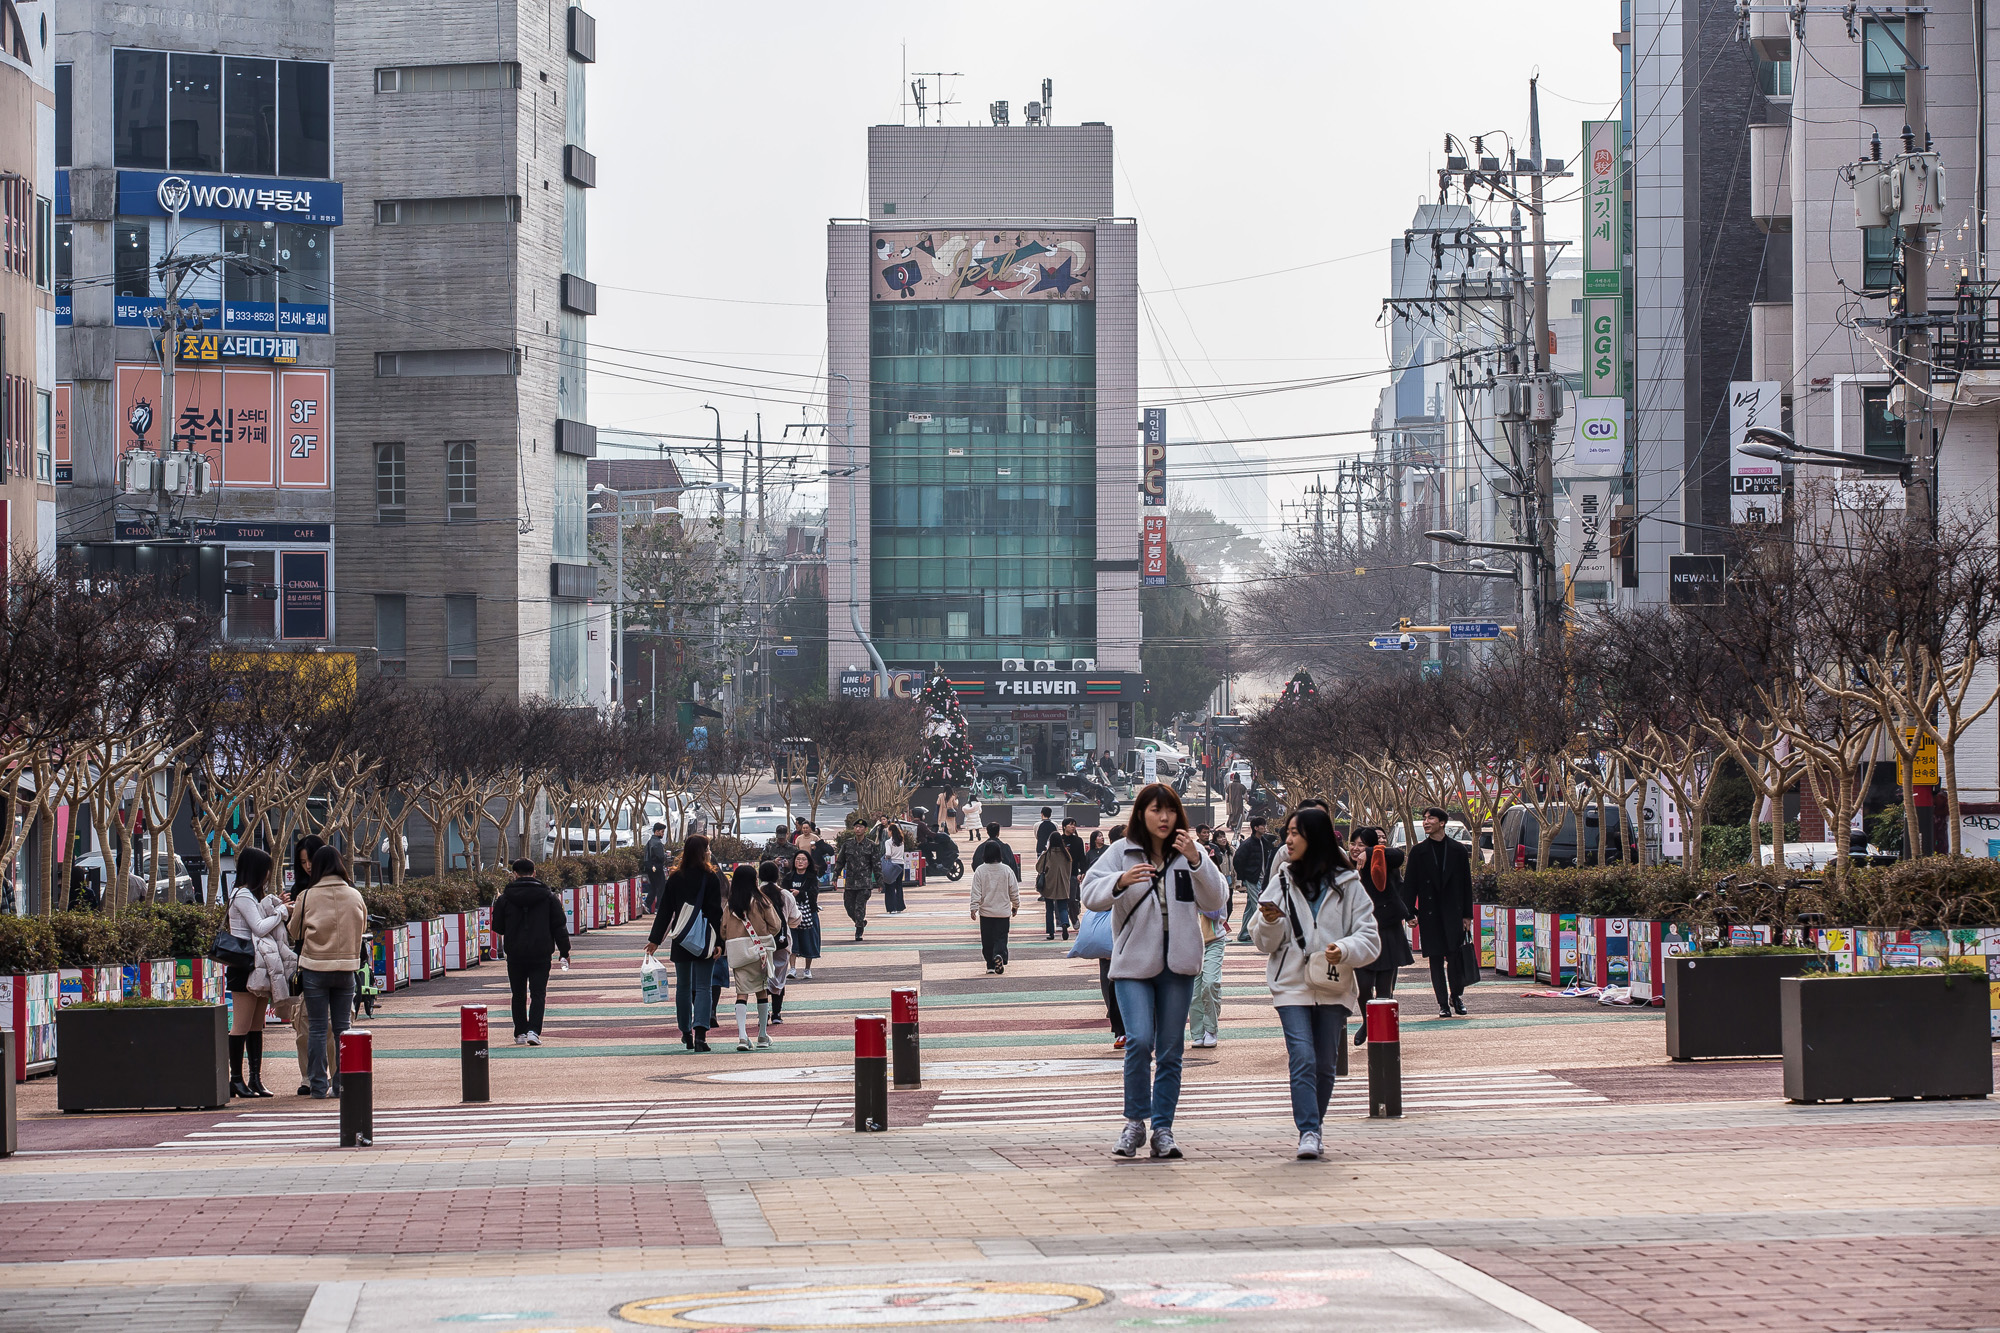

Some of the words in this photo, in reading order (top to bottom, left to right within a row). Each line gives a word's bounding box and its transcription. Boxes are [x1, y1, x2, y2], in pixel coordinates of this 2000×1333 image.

[192, 185, 255, 209] WOW
[256, 189, 312, 212] 부동산
[918, 230, 1048, 242] GALLERY
[235, 311, 275, 323] 333-8528
[182, 334, 219, 360] 초심
[237, 409, 268, 424] 스터디
[290, 399, 317, 424] 3F
[178, 407, 234, 444] 초심
[1149, 410, 1161, 441] 라인업
[1588, 423, 1611, 436] CU
[238, 426, 268, 445] 카페
[290, 434, 317, 459] 2F
[1145, 442, 1166, 495] PC
[1733, 477, 1753, 493] LP
[1753, 477, 1779, 485] MUSIC
[238, 528, 266, 538] STUDY
[294, 529, 315, 538] CAFE
[1147, 532, 1163, 573] 부동산
[288, 580, 319, 589] CHOSIM
[1674, 573, 1719, 582] NEWALL
[842, 686, 870, 698] 라인업
[1914, 769, 1936, 778] 단속중
